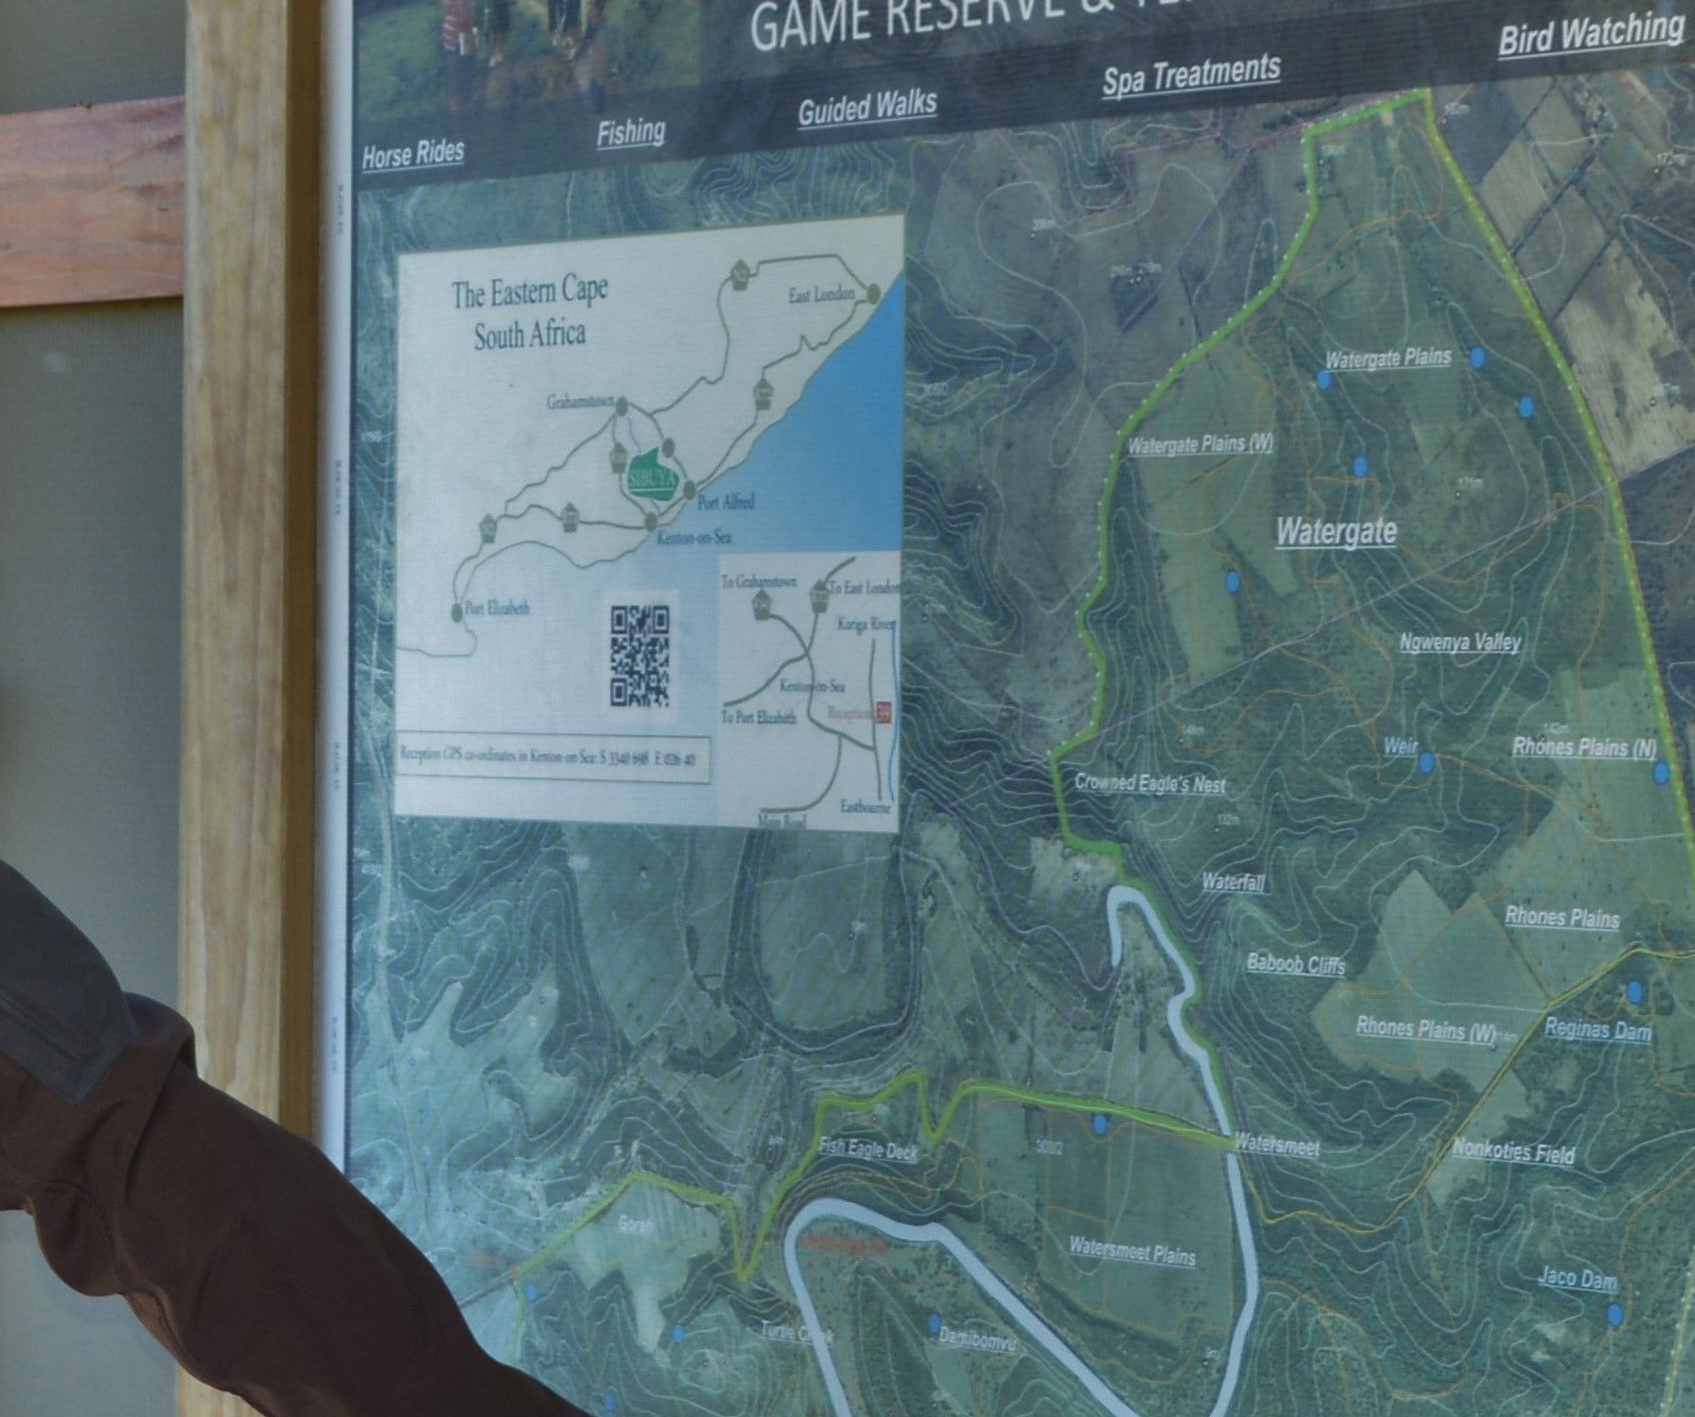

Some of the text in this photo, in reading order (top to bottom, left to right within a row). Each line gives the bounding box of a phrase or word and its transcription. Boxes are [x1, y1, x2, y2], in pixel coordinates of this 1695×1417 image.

[1499, 12, 1686, 56] Bird Watching
[1103, 52, 1282, 98] Spa Treatments
[797, 88, 937, 126] Guided Walks
[597, 118, 666, 149] Fishing
[362, 138, 465, 170] Horse Rides
[453, 272, 609, 309] The Eastern Cape
[789, 283, 855, 304] East London
[474, 317, 587, 351] South Africa
[1325, 347, 1452, 373] Watergate Plains
[1128, 432, 1274, 457] Watergate Plains (W)
[698, 491, 755, 511] Port Alfred
[1276, 517, 1398, 550] Watergate
[1400, 633, 1521, 654] Ngwenya Valley
[1384, 736, 1418, 755] Weir
[1512, 737, 1657, 760] Rhones Plains (N)
[1075, 773, 1226, 796] Crowned Eagle's Nest
[1202, 873, 1265, 892] Waterfall
[1506, 905, 1620, 929] Rhones Plains
[1308, 954, 1346, 976] Cliffs
[1356, 1016, 1496, 1044] Rhones Plains (W)
[1545, 1017, 1652, 1042] Reginas Dam
[819, 1136, 845, 1155] Fish
[849, 1138, 882, 1159] Eagle
[1236, 1132, 1320, 1157] Watersmeet
[1537, 1143, 1576, 1165] Field
[1070, 1235, 1196, 1267] Watersmeet Plains
[1539, 1266, 1618, 1292] Jaco Dam
